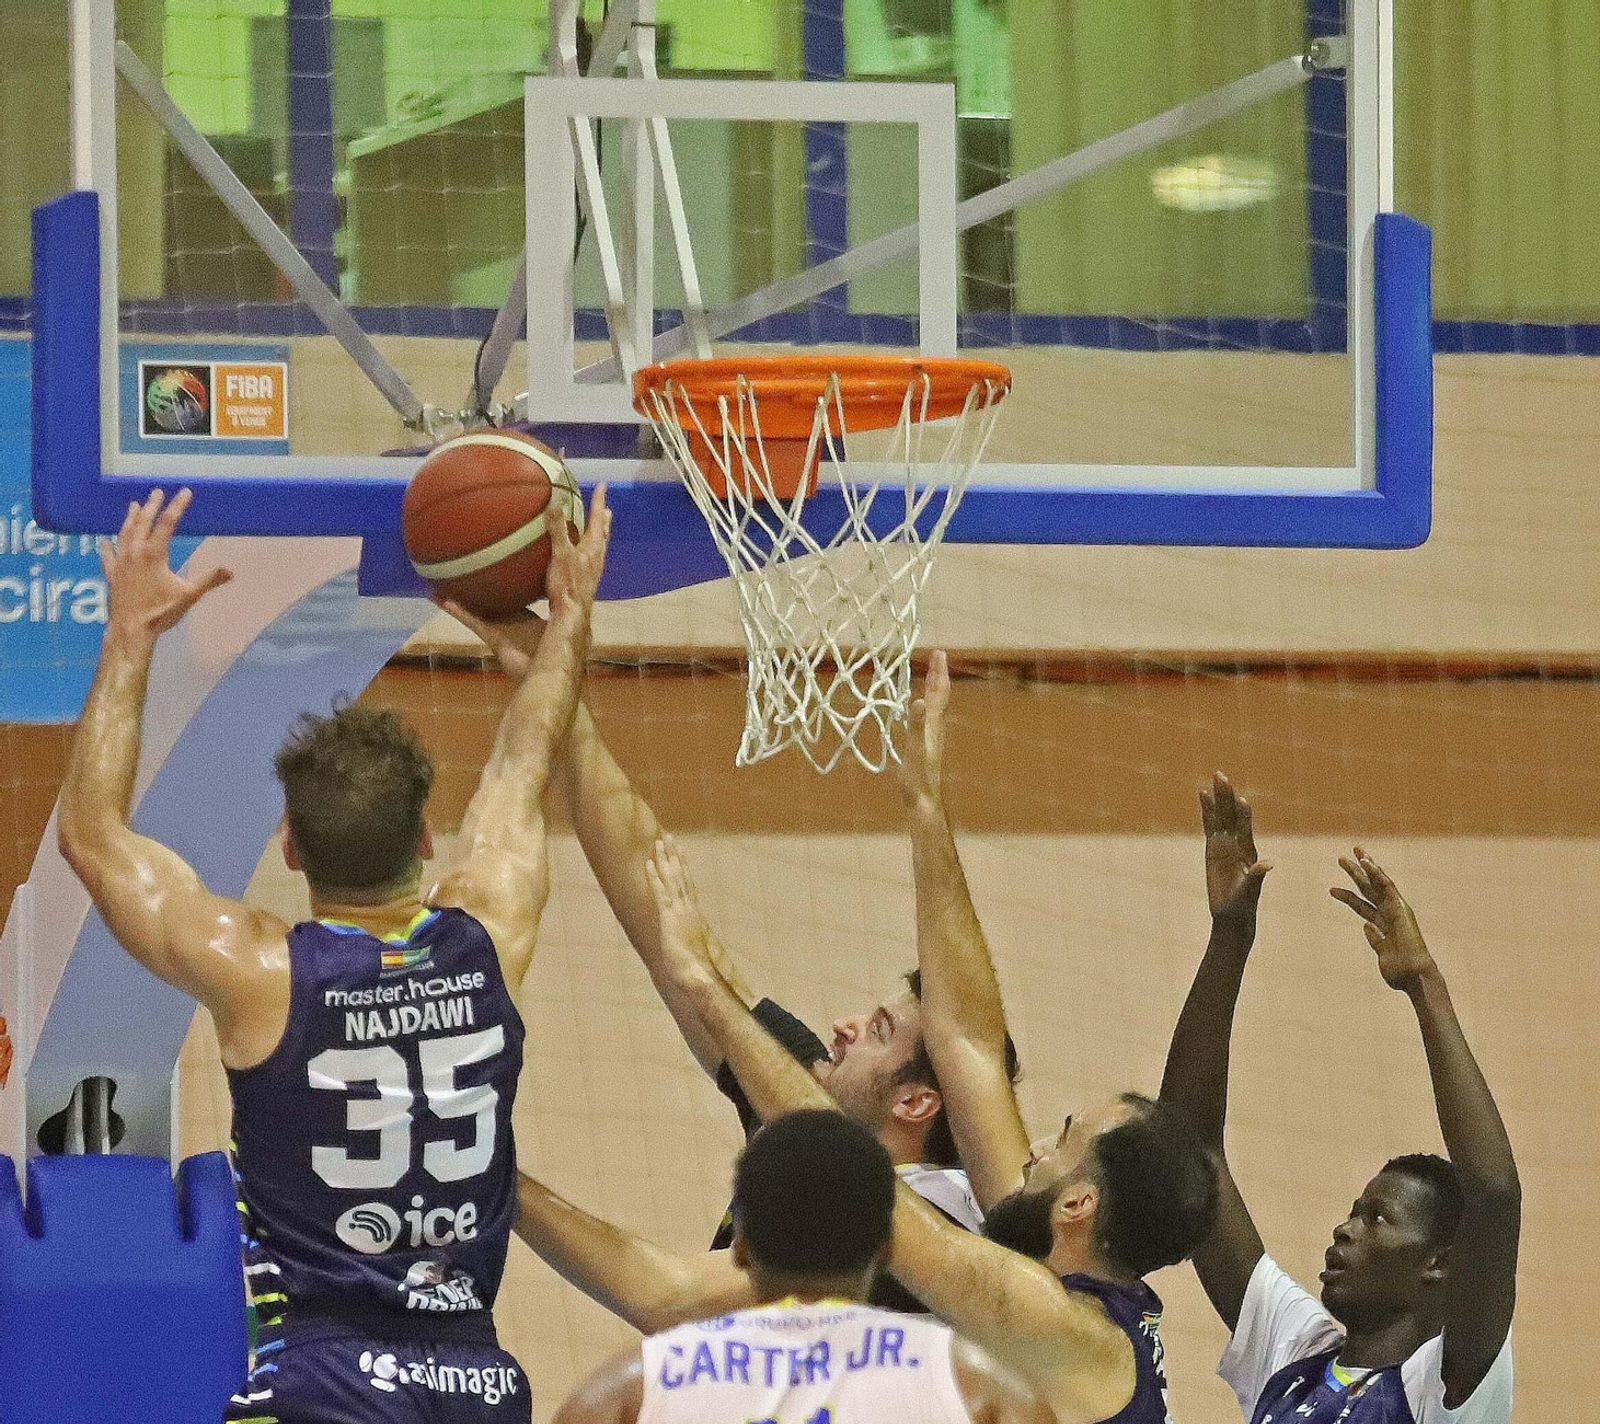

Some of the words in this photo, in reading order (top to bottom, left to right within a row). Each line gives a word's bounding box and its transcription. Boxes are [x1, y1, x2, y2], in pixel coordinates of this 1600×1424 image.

[225, 375, 274, 399] FIBA
[345, 996, 475, 1041] NAJDAWI
[307, 1025, 505, 1189] 35
[404, 1194, 478, 1247] ice
[845, 1326, 921, 1371] JR.
